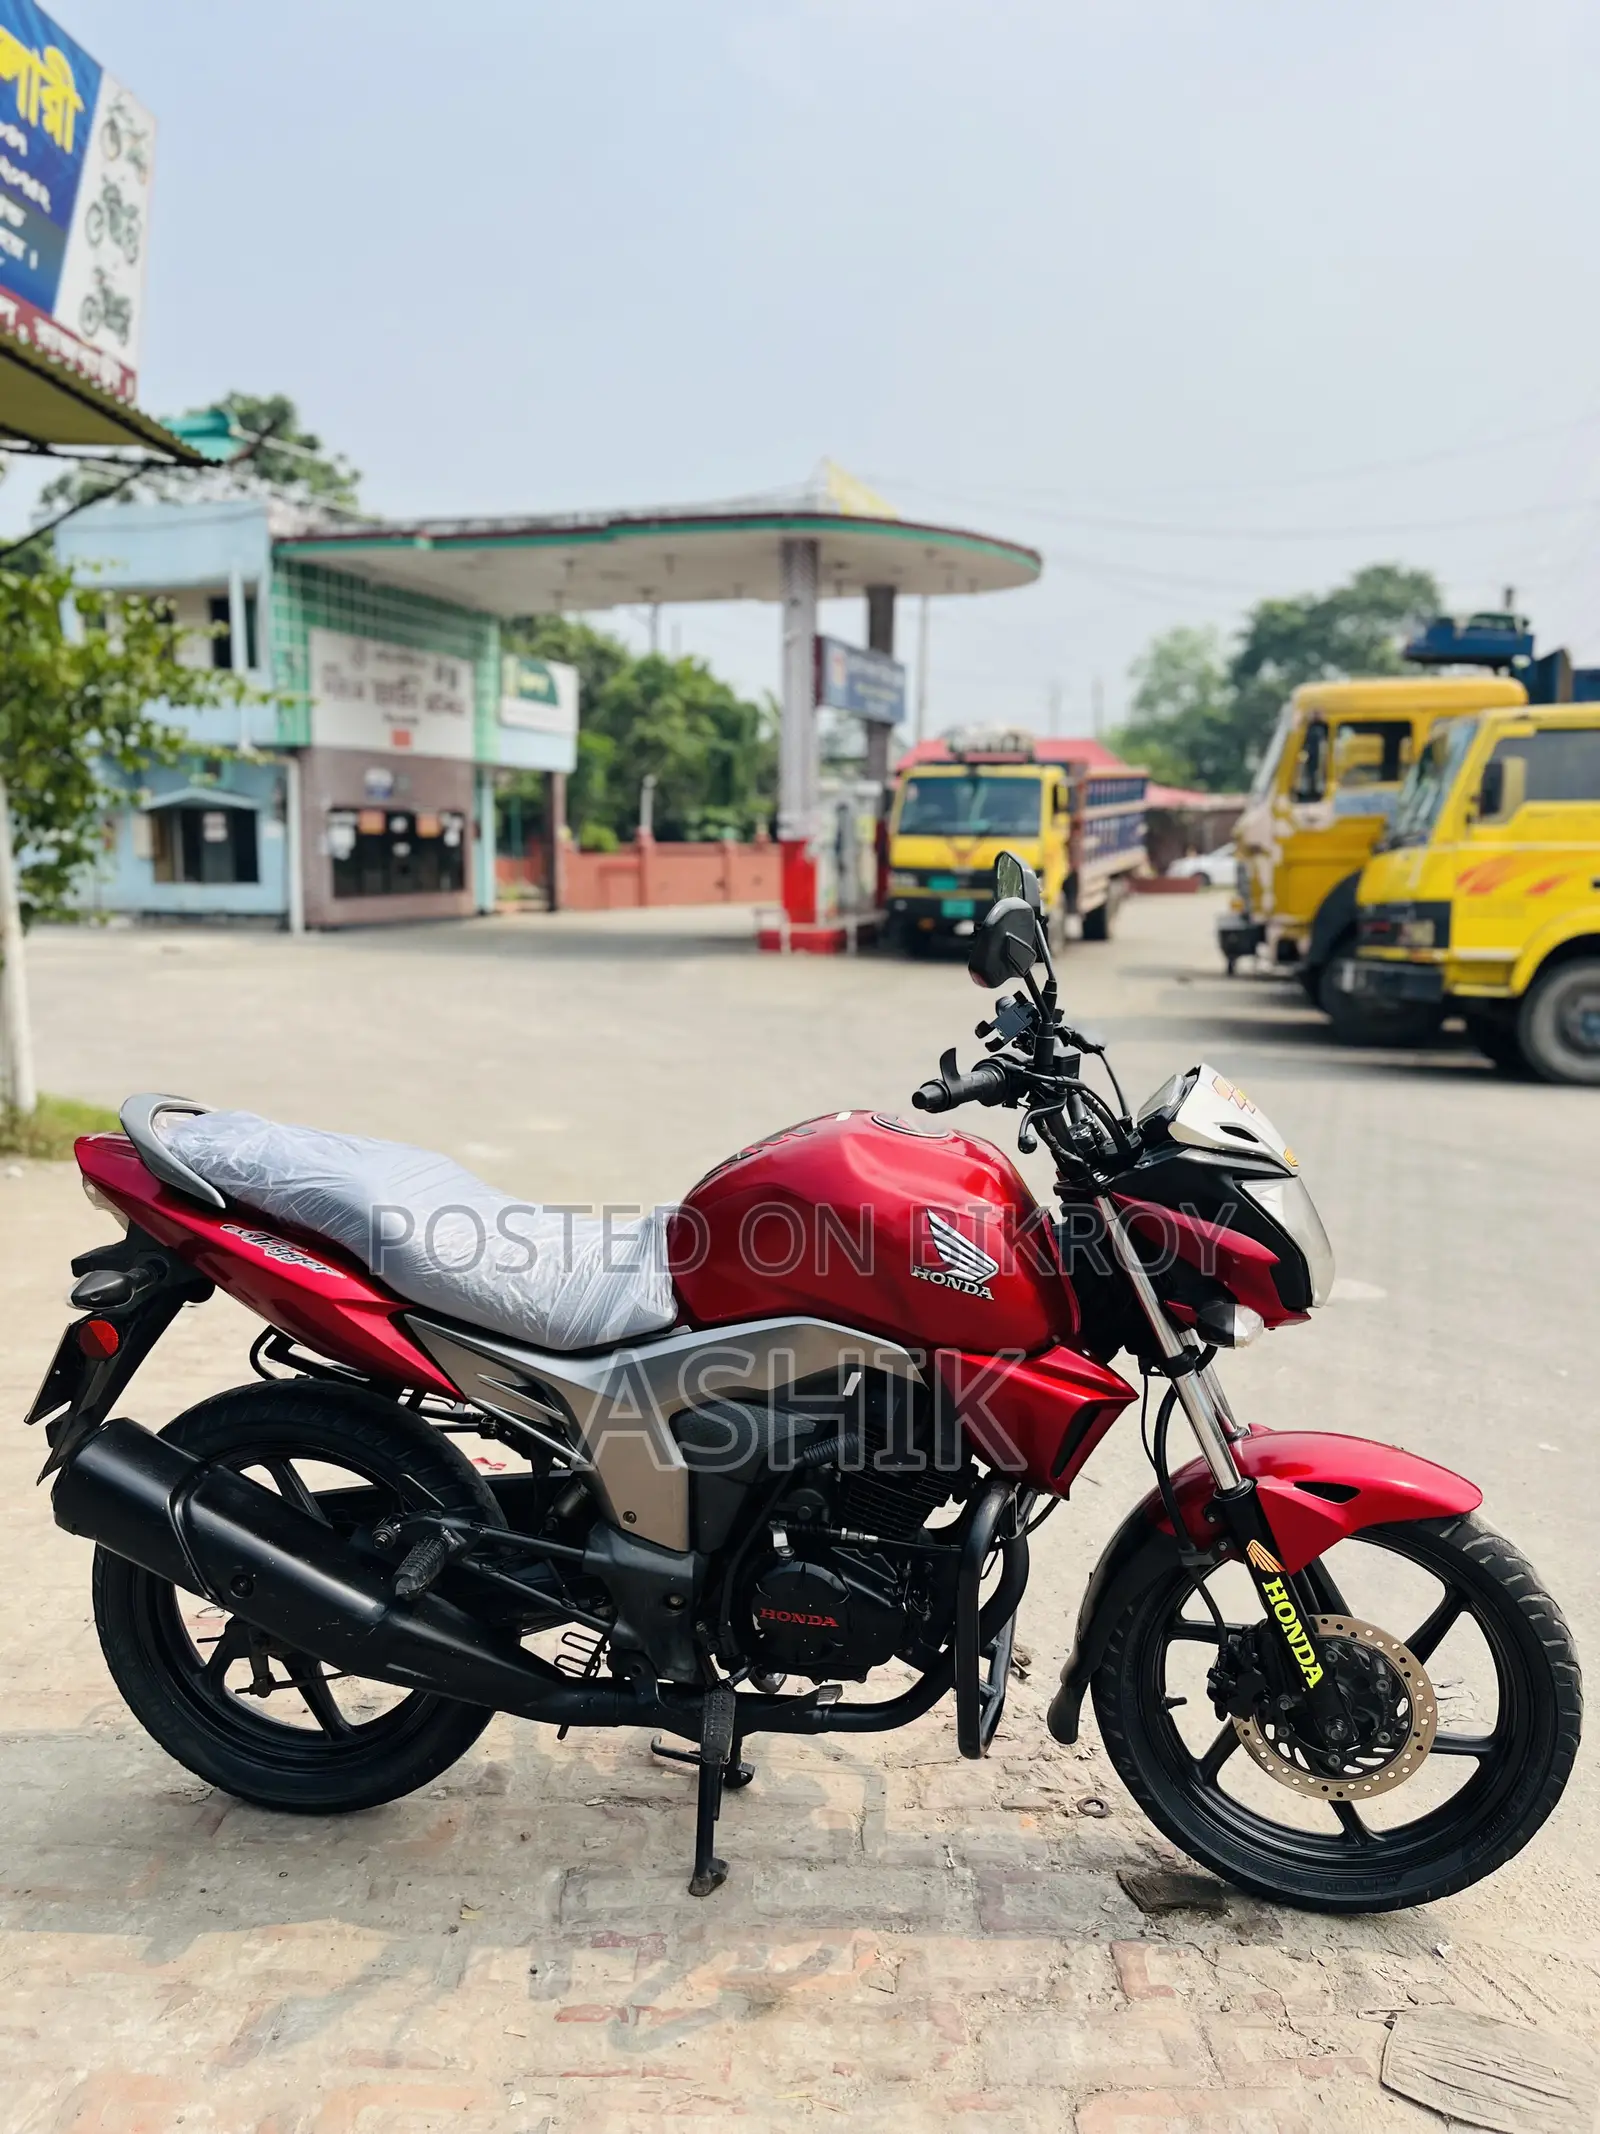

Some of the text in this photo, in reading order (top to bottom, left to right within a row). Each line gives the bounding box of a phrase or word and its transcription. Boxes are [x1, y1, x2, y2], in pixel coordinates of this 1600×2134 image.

[911, 1265, 996, 1301] HONDA
[760, 1607, 840, 1628] HONDA
[1262, 1576, 1324, 1689] HONDA
